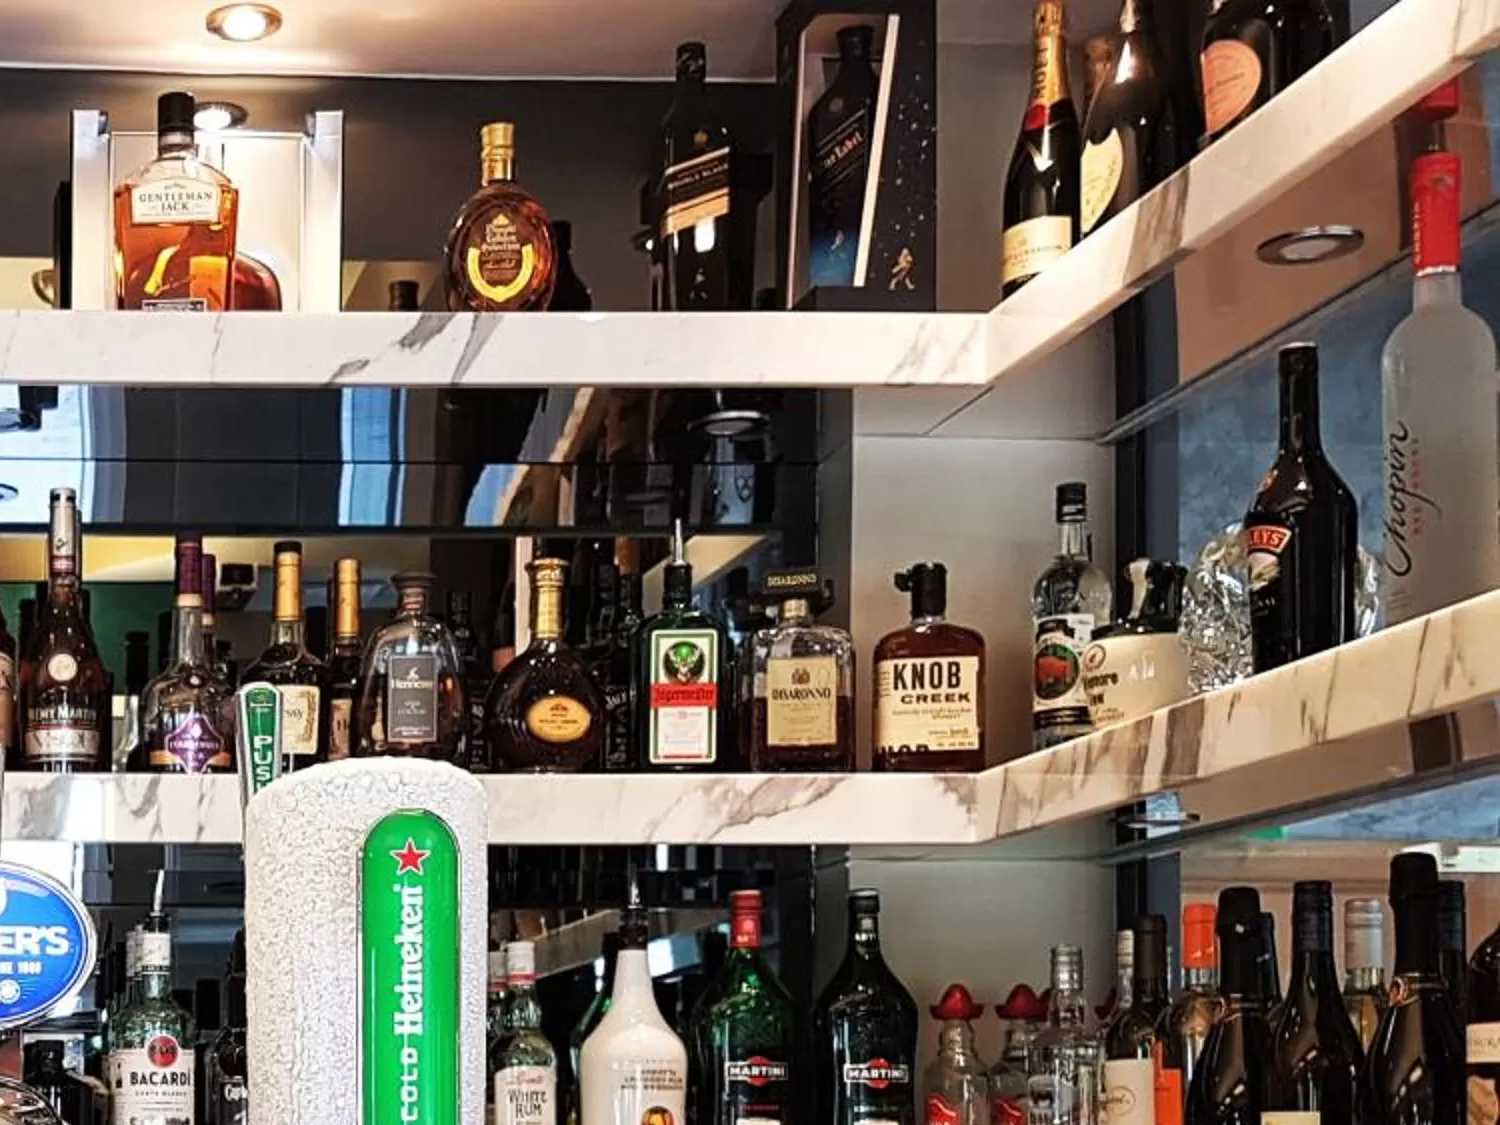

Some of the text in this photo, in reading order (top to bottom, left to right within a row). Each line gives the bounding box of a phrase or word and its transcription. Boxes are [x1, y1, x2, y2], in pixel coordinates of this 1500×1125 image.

[139, 191, 212, 202] GENTLEMAN
[161, 202, 189, 212] JACK
[1385, 421, 1441, 577] Chopin
[893, 661, 961, 691] KNOB
[900, 692, 971, 705] CREEK
[393, 883, 425, 1036] Heineken
[729, 1066, 786, 1077] MARTINI
[849, 1068, 905, 1079] MARTINI
[401, 1047, 419, 1120] COLD
[508, 1089, 547, 1103] WHITE
[516, 1103, 543, 1118] RUM
